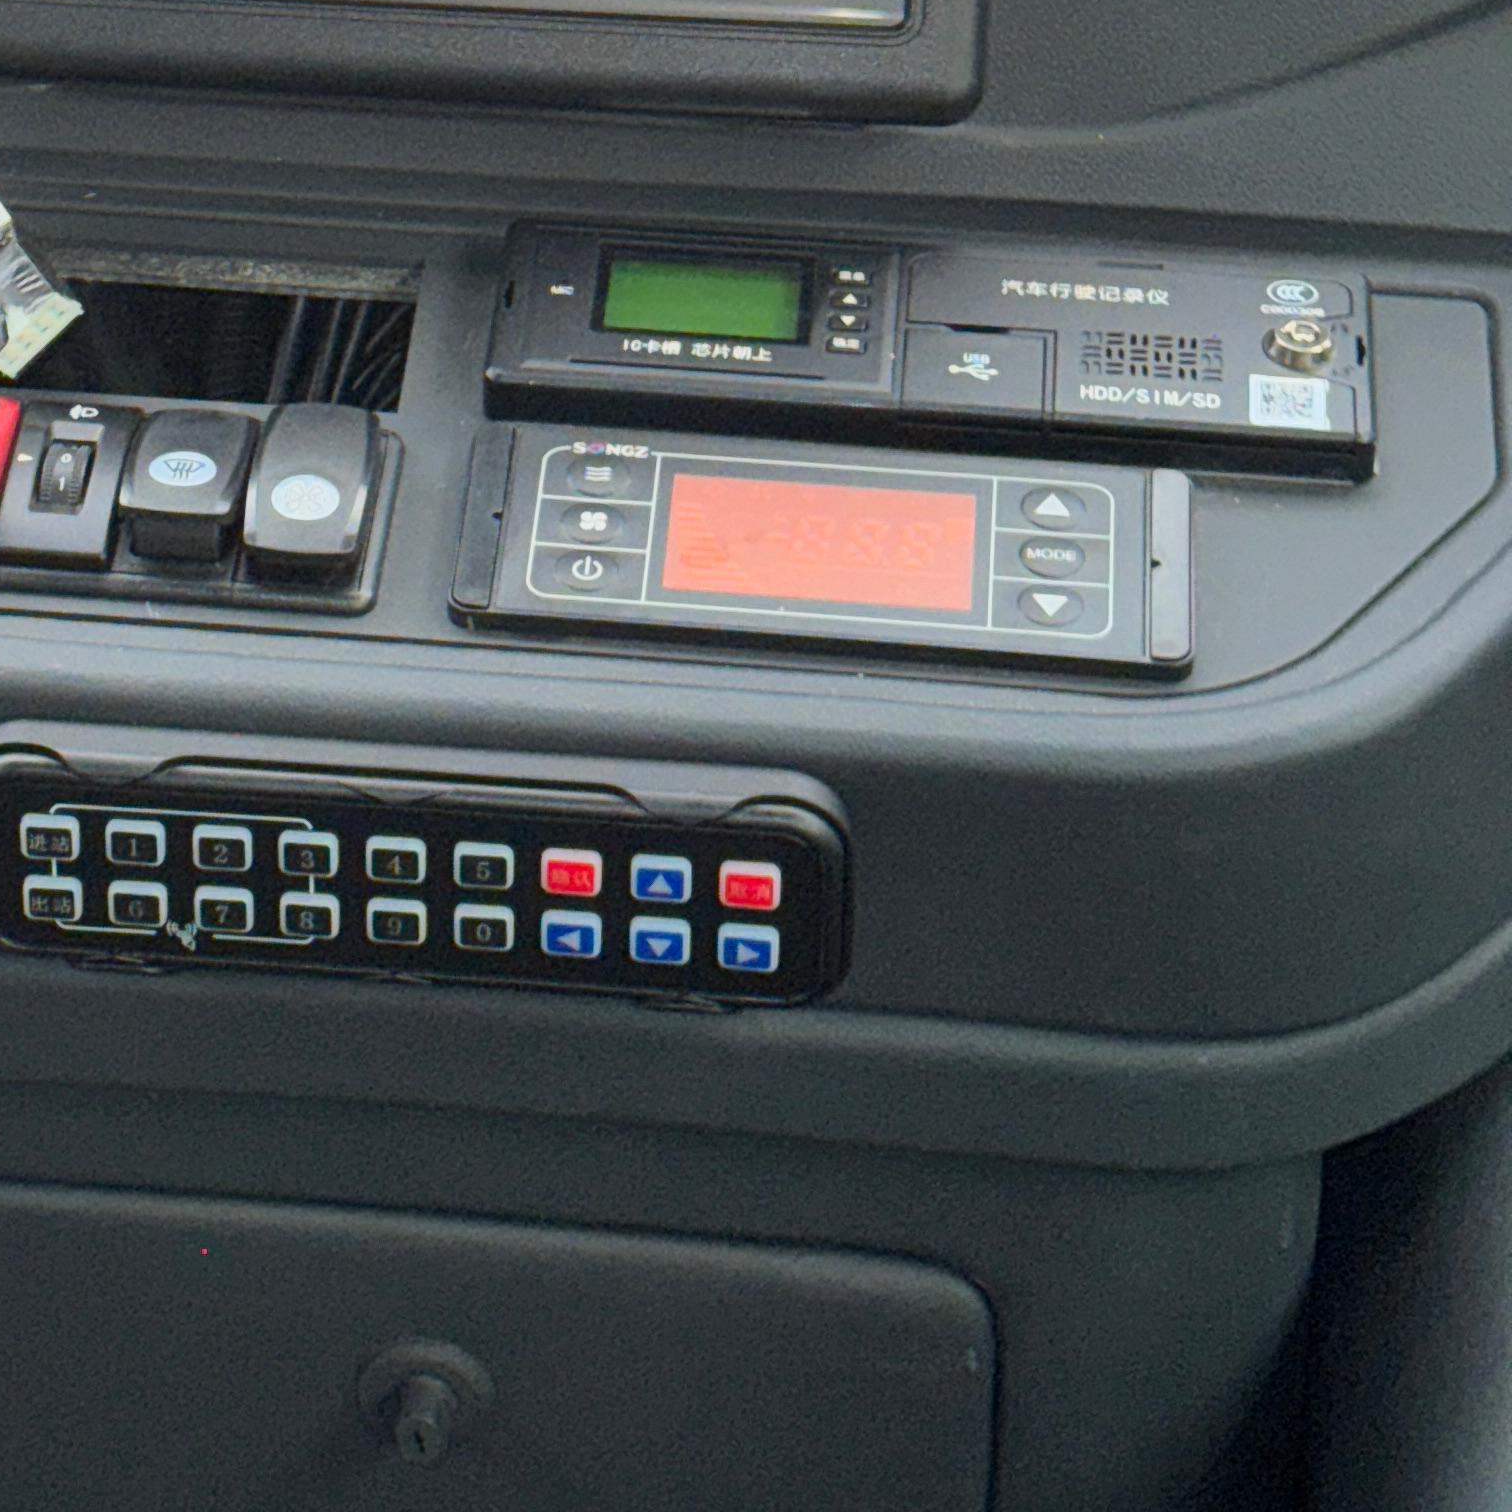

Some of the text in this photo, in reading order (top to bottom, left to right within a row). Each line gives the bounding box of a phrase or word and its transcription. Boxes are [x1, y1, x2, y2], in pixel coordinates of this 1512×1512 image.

[1000, 278, 1170, 306] 汽车行驶记录仪
[962, 351, 991, 364] USB
[1080, 383, 1222, 410] HDD/SIM/SD
[571, 441, 650, 459] SONGZ
[1026, 546, 1077, 563] MODE
[126, 837, 139, 859] 1
[213, 844, 229, 865] 2
[300, 849, 315, 871] 3
[386, 854, 403, 876] 4
[475, 860, 491, 881] 5
[128, 899, 144, 921] 6
[214, 904, 230, 927] 7
[300, 910, 315, 932] 8
[386, 915, 403, 937] 9
[475, 922, 492, 944] 0
